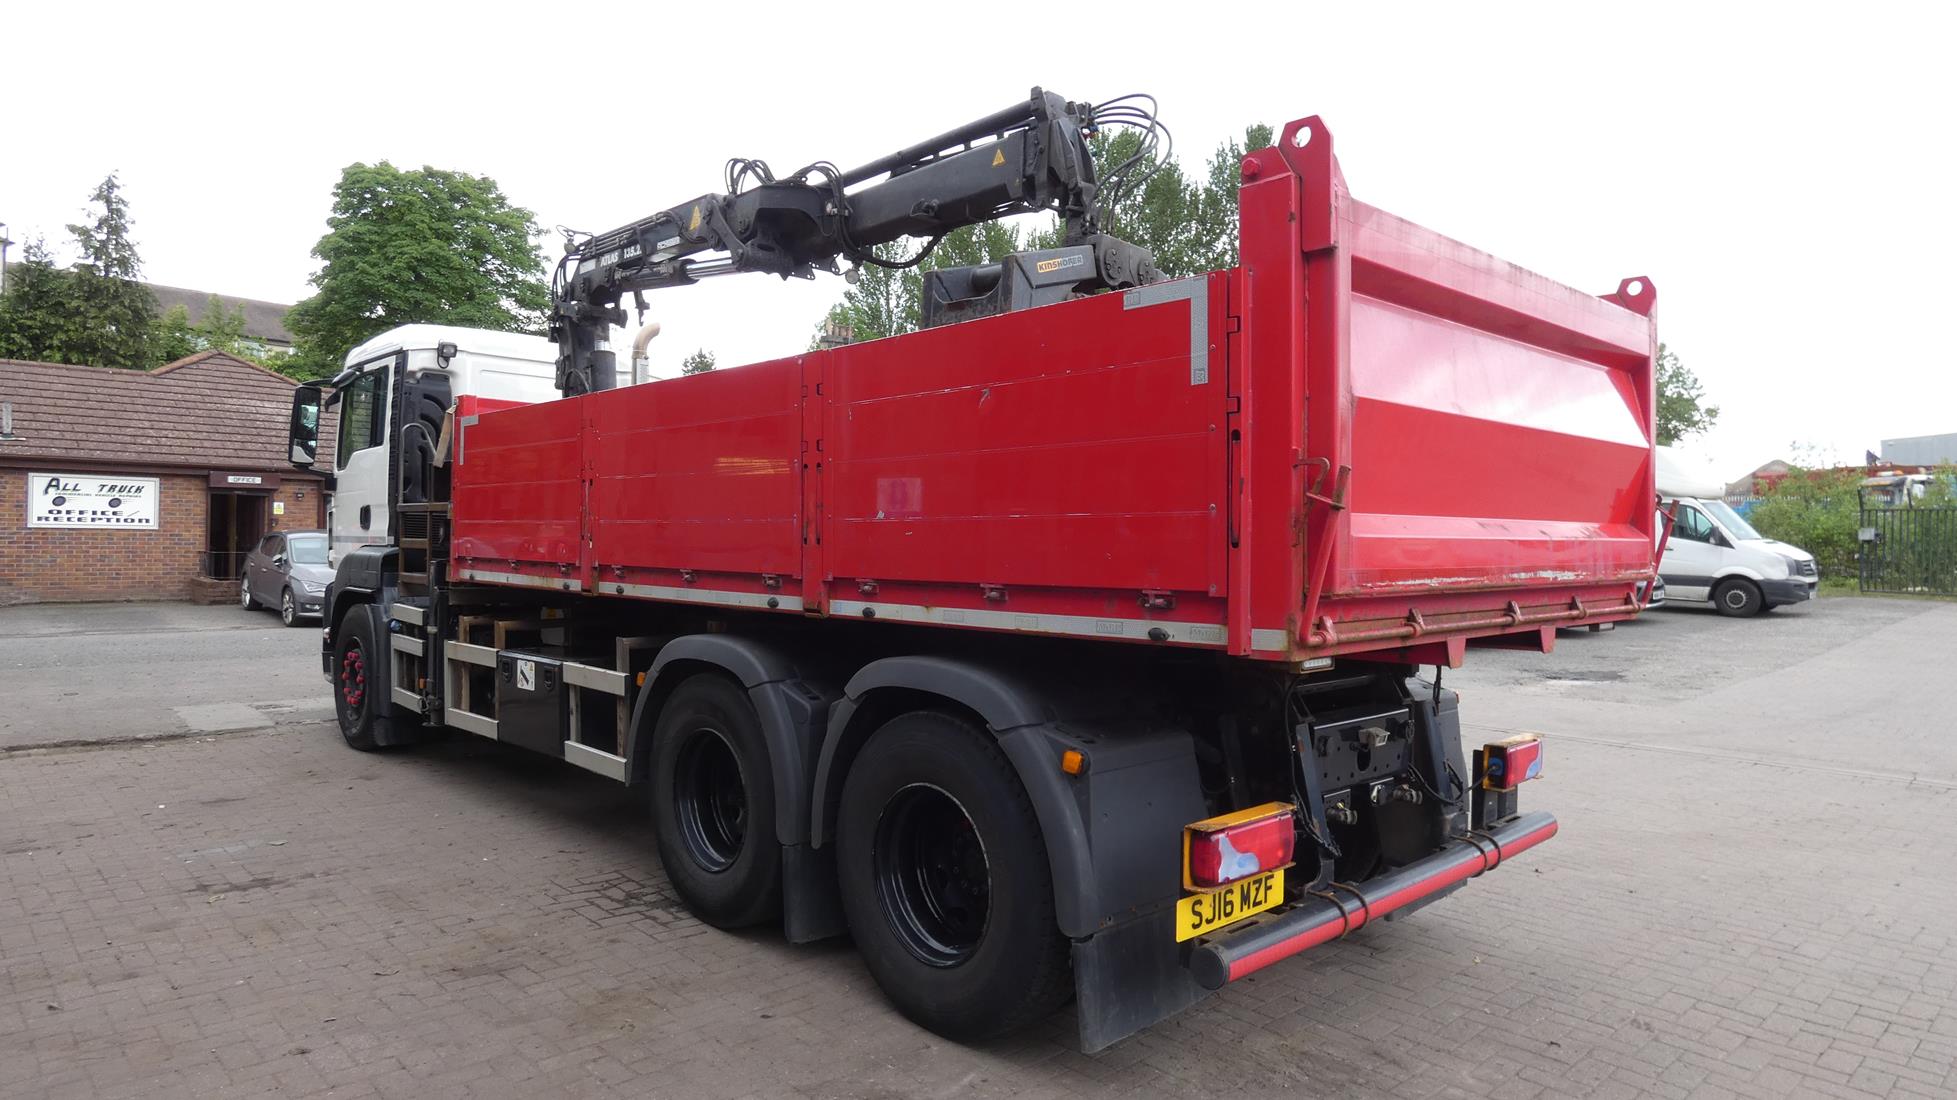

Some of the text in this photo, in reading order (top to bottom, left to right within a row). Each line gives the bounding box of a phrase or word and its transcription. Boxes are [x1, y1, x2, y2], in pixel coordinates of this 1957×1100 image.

[601, 252, 619, 267] ATLAS
[623, 243, 642, 259] 135.2
[1038, 256, 1082, 271] KINSHOFER
[43, 477, 144, 495] ALL TRUCK
[37, 516, 150, 524] RECEPTION
[1191, 874, 1274, 930] SJ16 MZF
